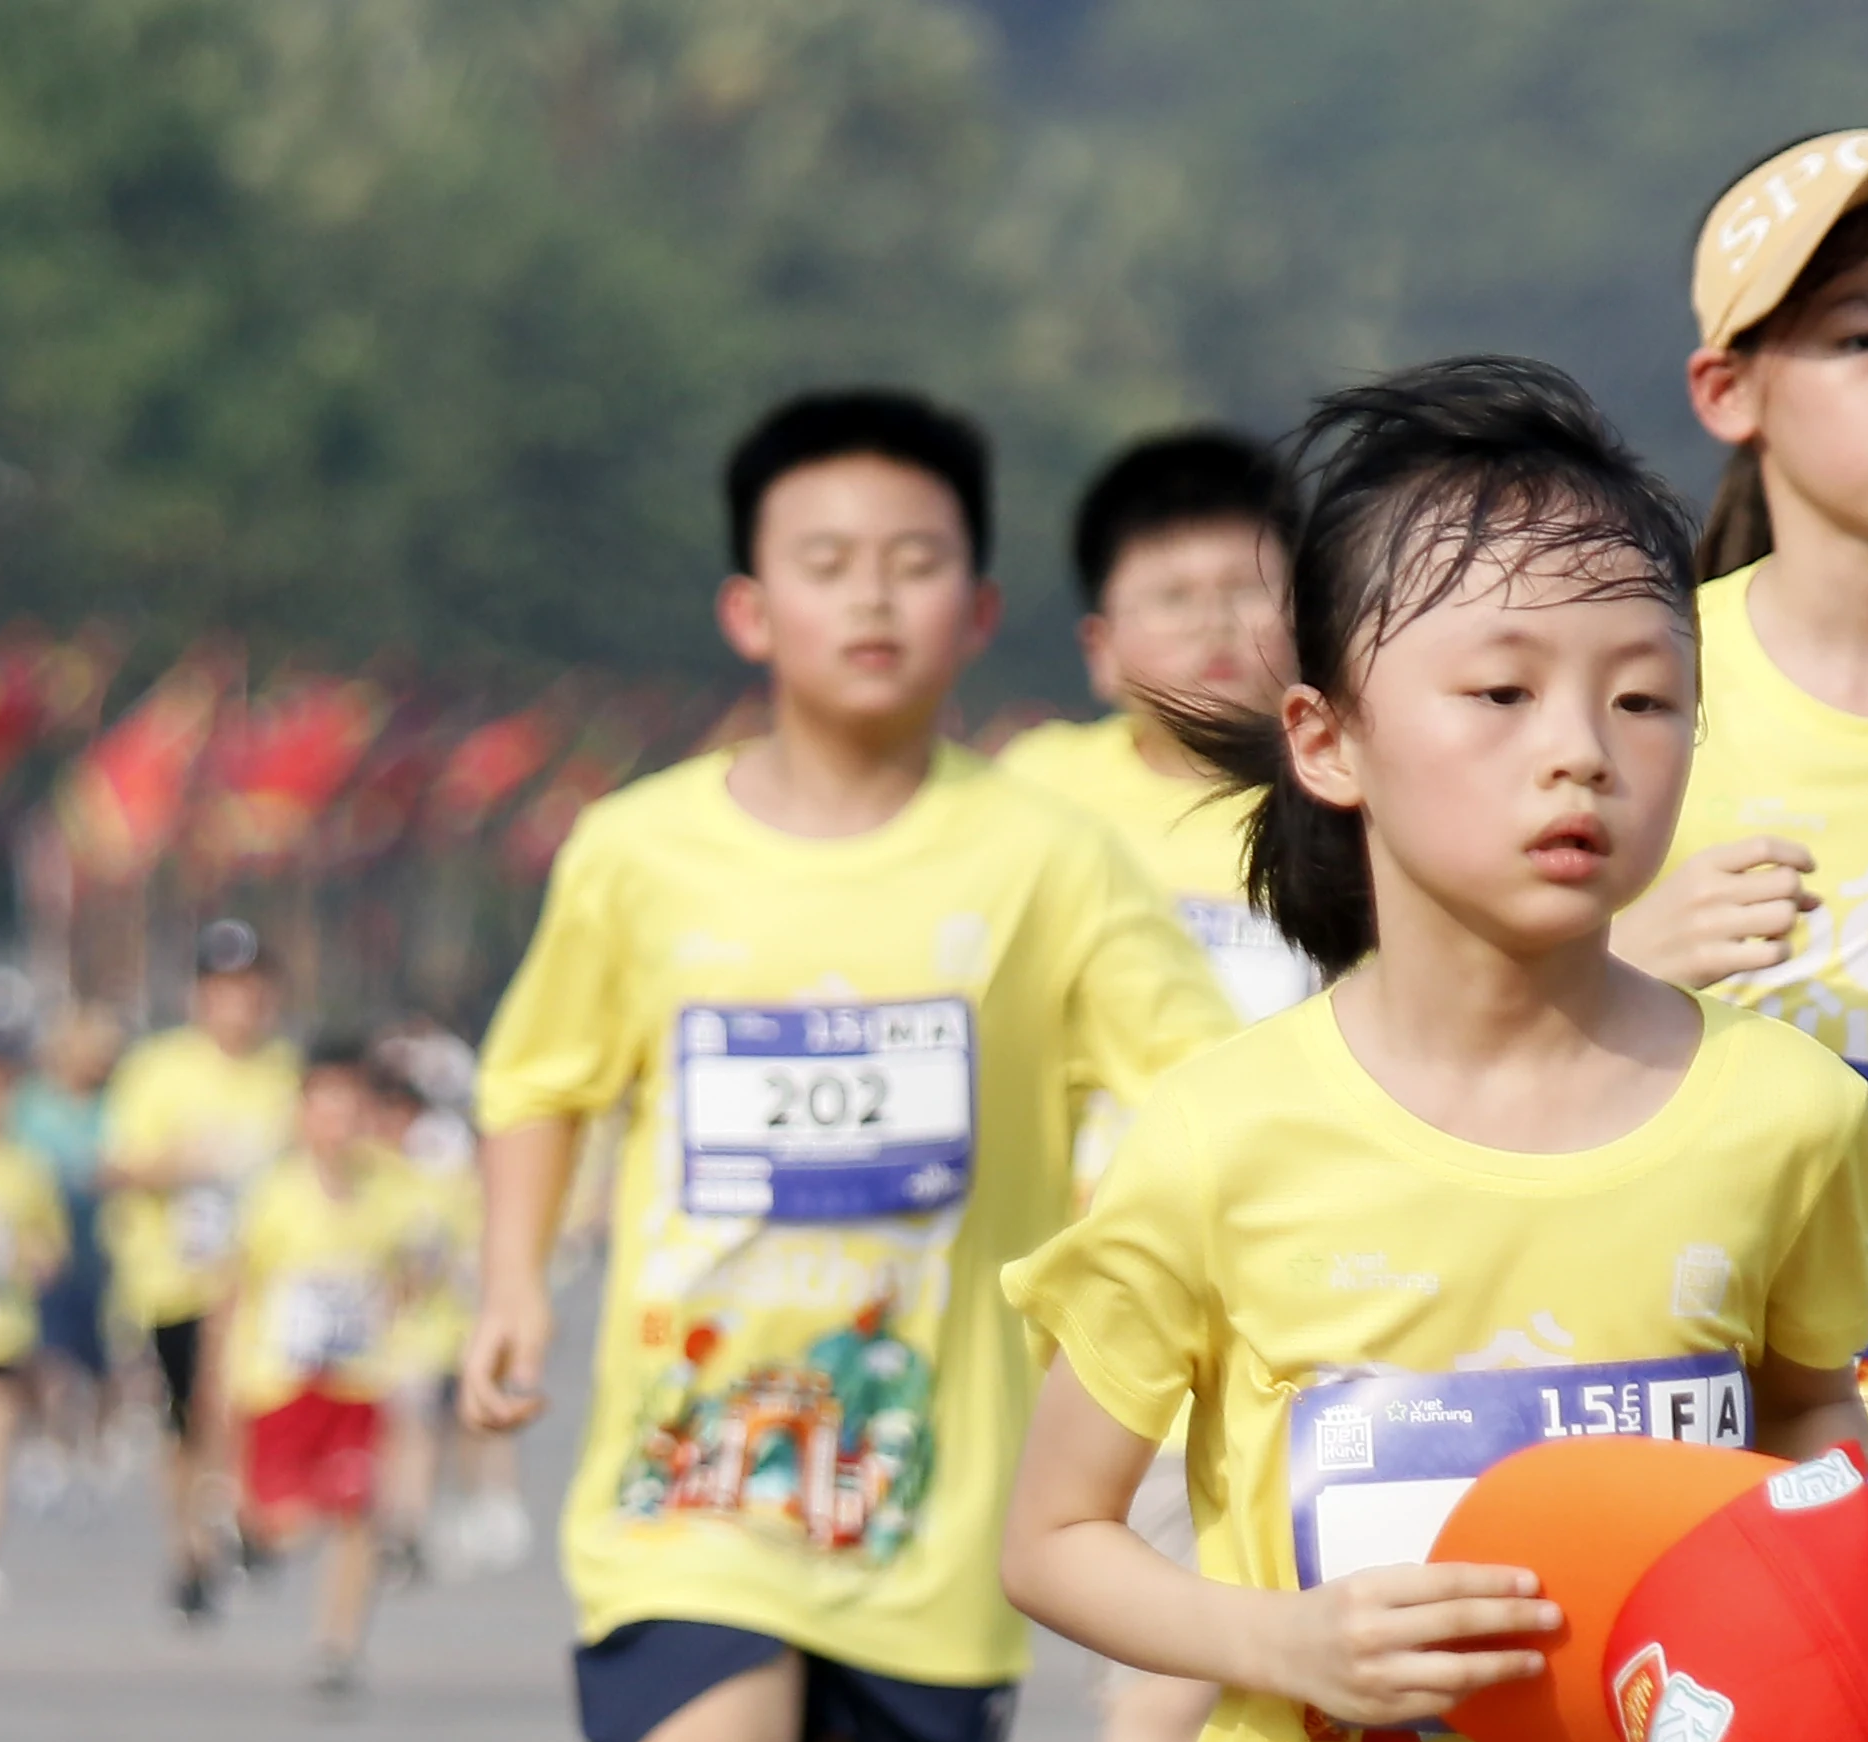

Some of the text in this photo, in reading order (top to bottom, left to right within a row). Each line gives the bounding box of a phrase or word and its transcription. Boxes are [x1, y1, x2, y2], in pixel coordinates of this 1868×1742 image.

[760, 1064, 892, 1128] 202
[1410, 1398, 1444, 1411] Viet
[1410, 1409, 1473, 1424] Running
[1541, 1383, 1740, 1441] 1.5 km F A
